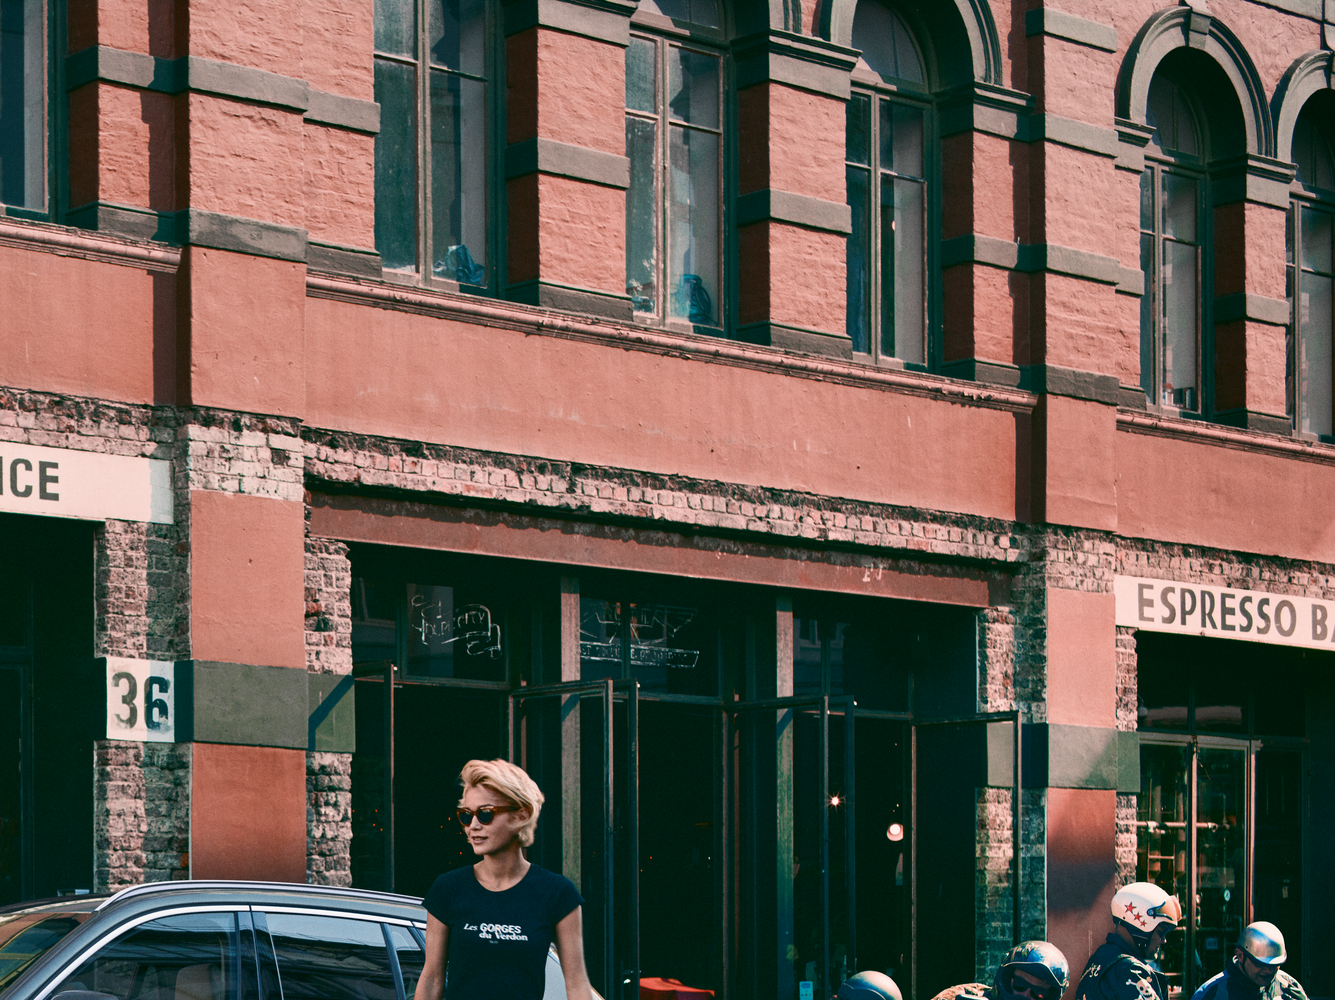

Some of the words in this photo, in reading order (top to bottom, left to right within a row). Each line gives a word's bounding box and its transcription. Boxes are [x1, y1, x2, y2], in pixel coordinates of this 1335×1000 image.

[1137, 583, 1297, 638] ESPRESSO
[112, 671, 169, 731] 36
[463, 923, 479, 932] Les
[479, 922, 522, 934] GORGES
[479, 931, 492, 939] du
[495, 930, 529, 941] Verdon
